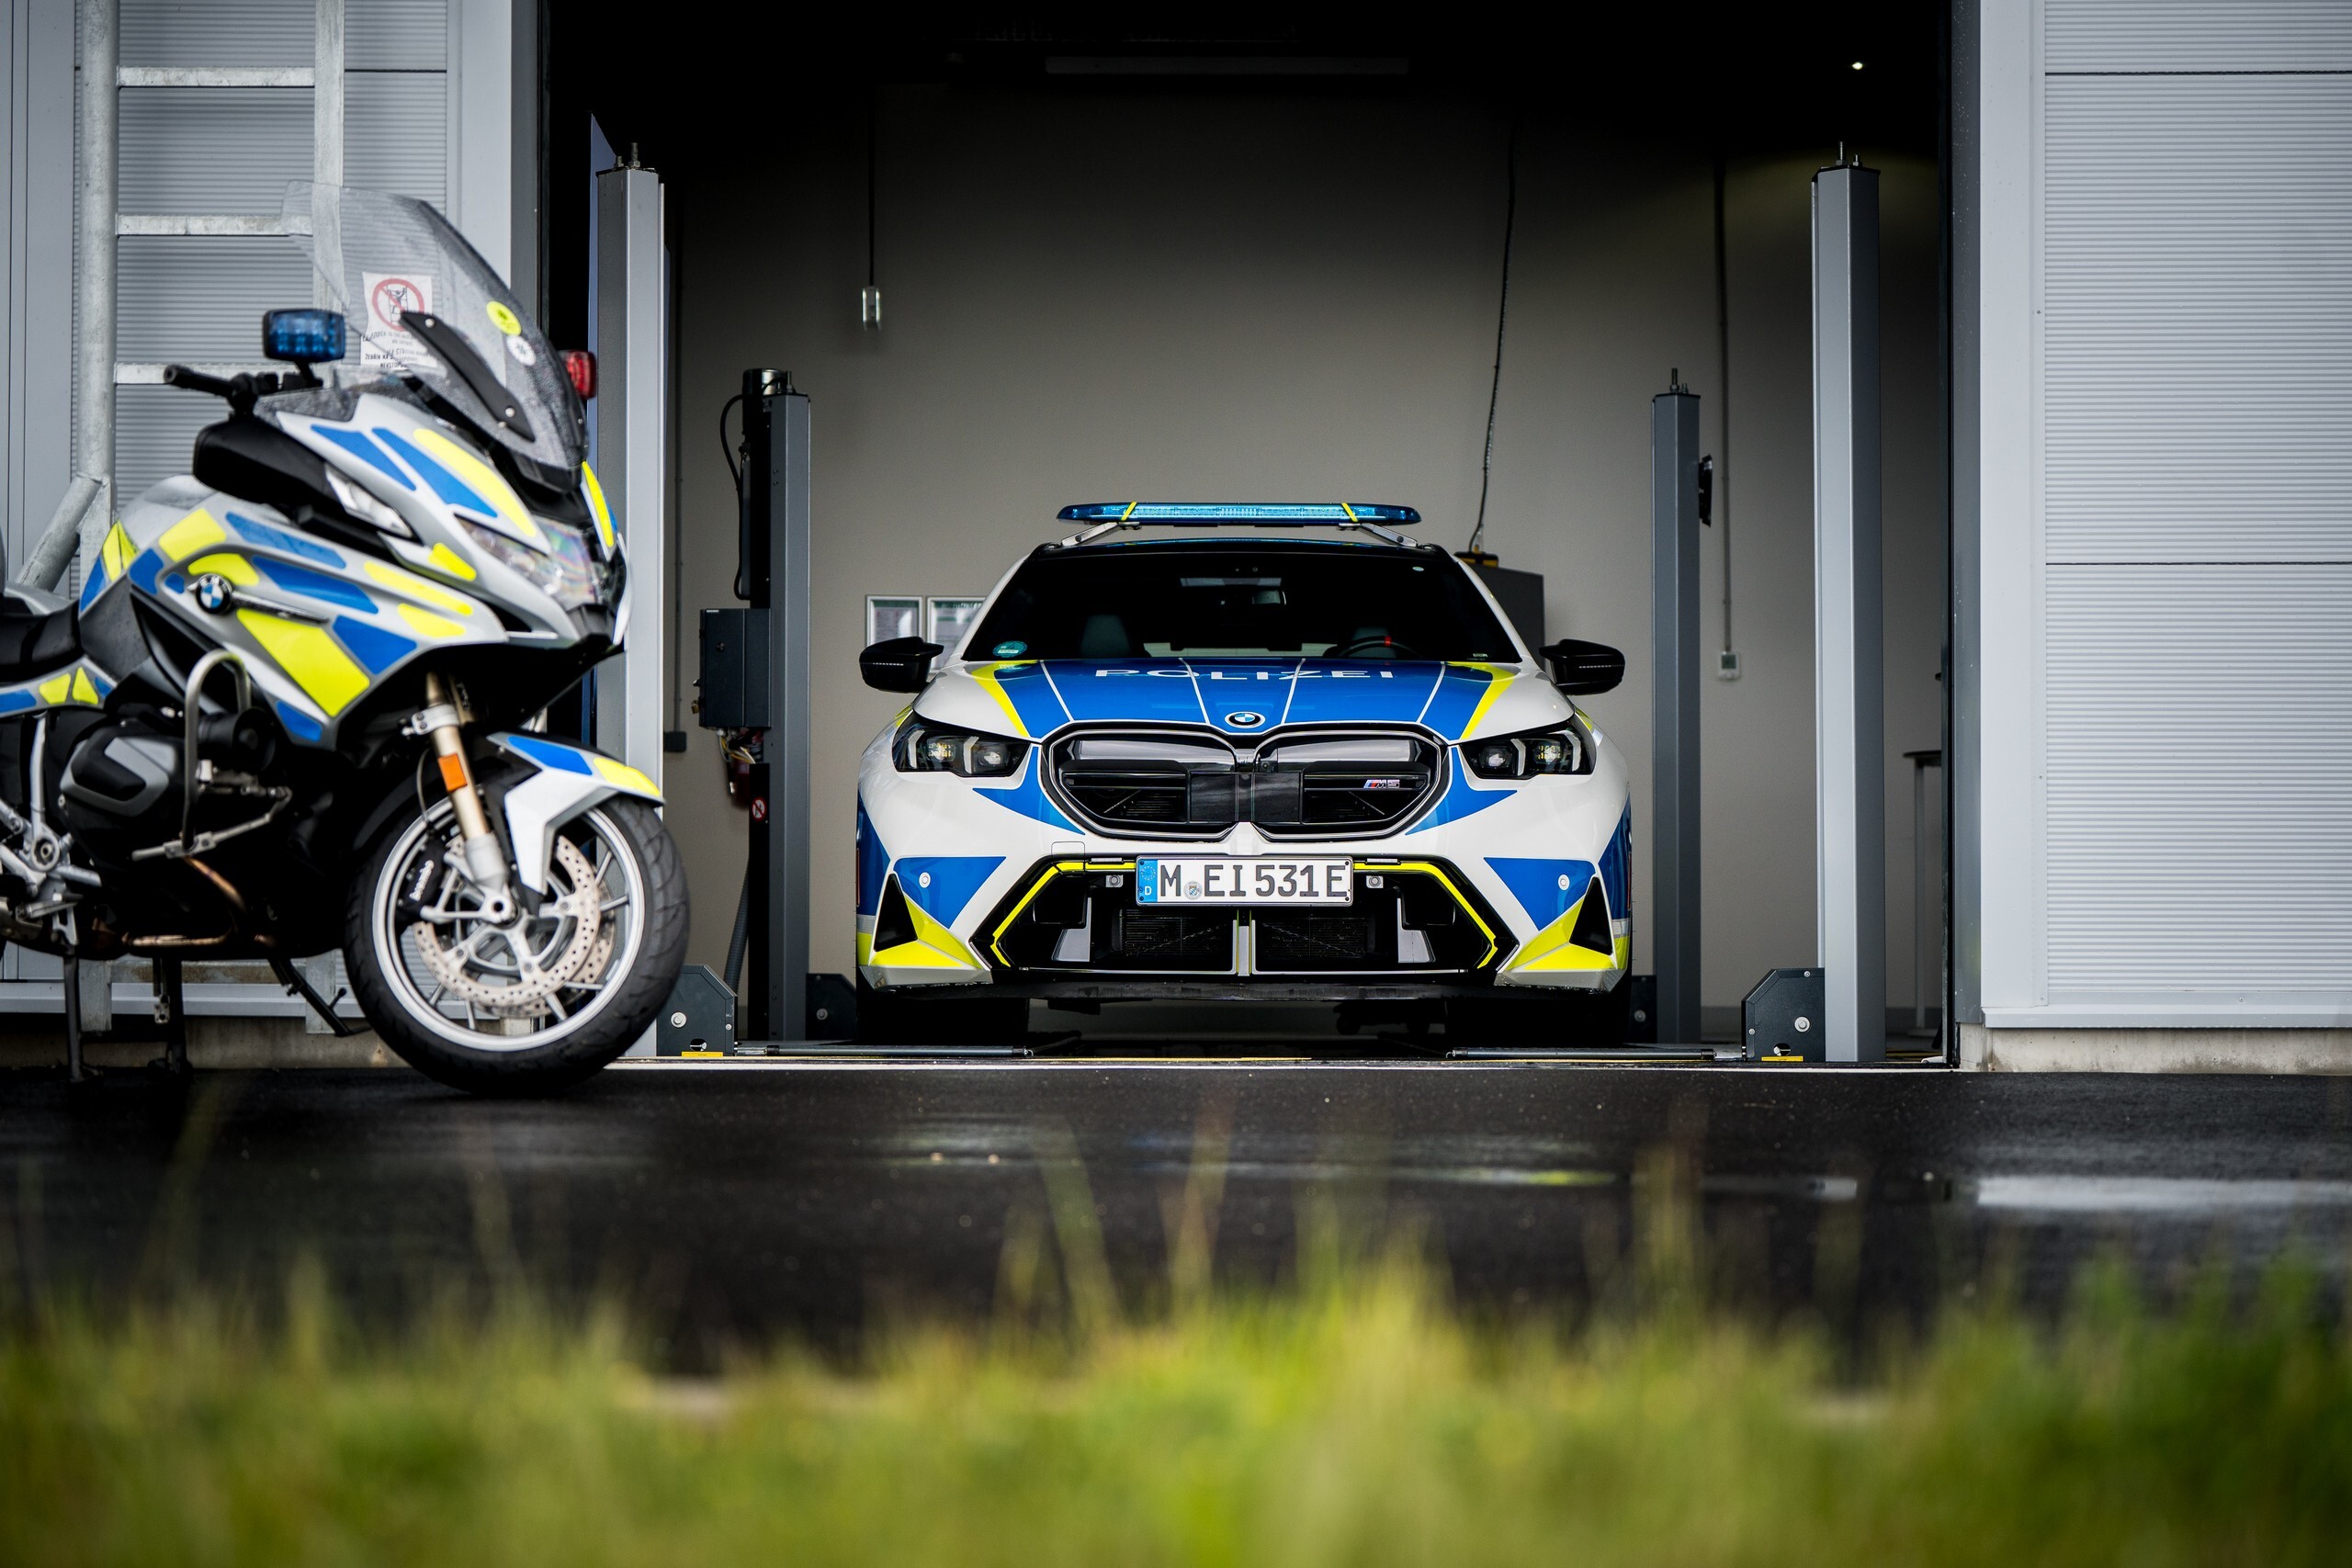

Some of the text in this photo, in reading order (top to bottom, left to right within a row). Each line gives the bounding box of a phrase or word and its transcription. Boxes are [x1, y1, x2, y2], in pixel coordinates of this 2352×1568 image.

[1095, 670, 1394, 681] POLIZEI
[1368, 779, 1400, 789] M5
[1160, 864, 1348, 897] M EI 531E
[1144, 886, 1152, 896] D
